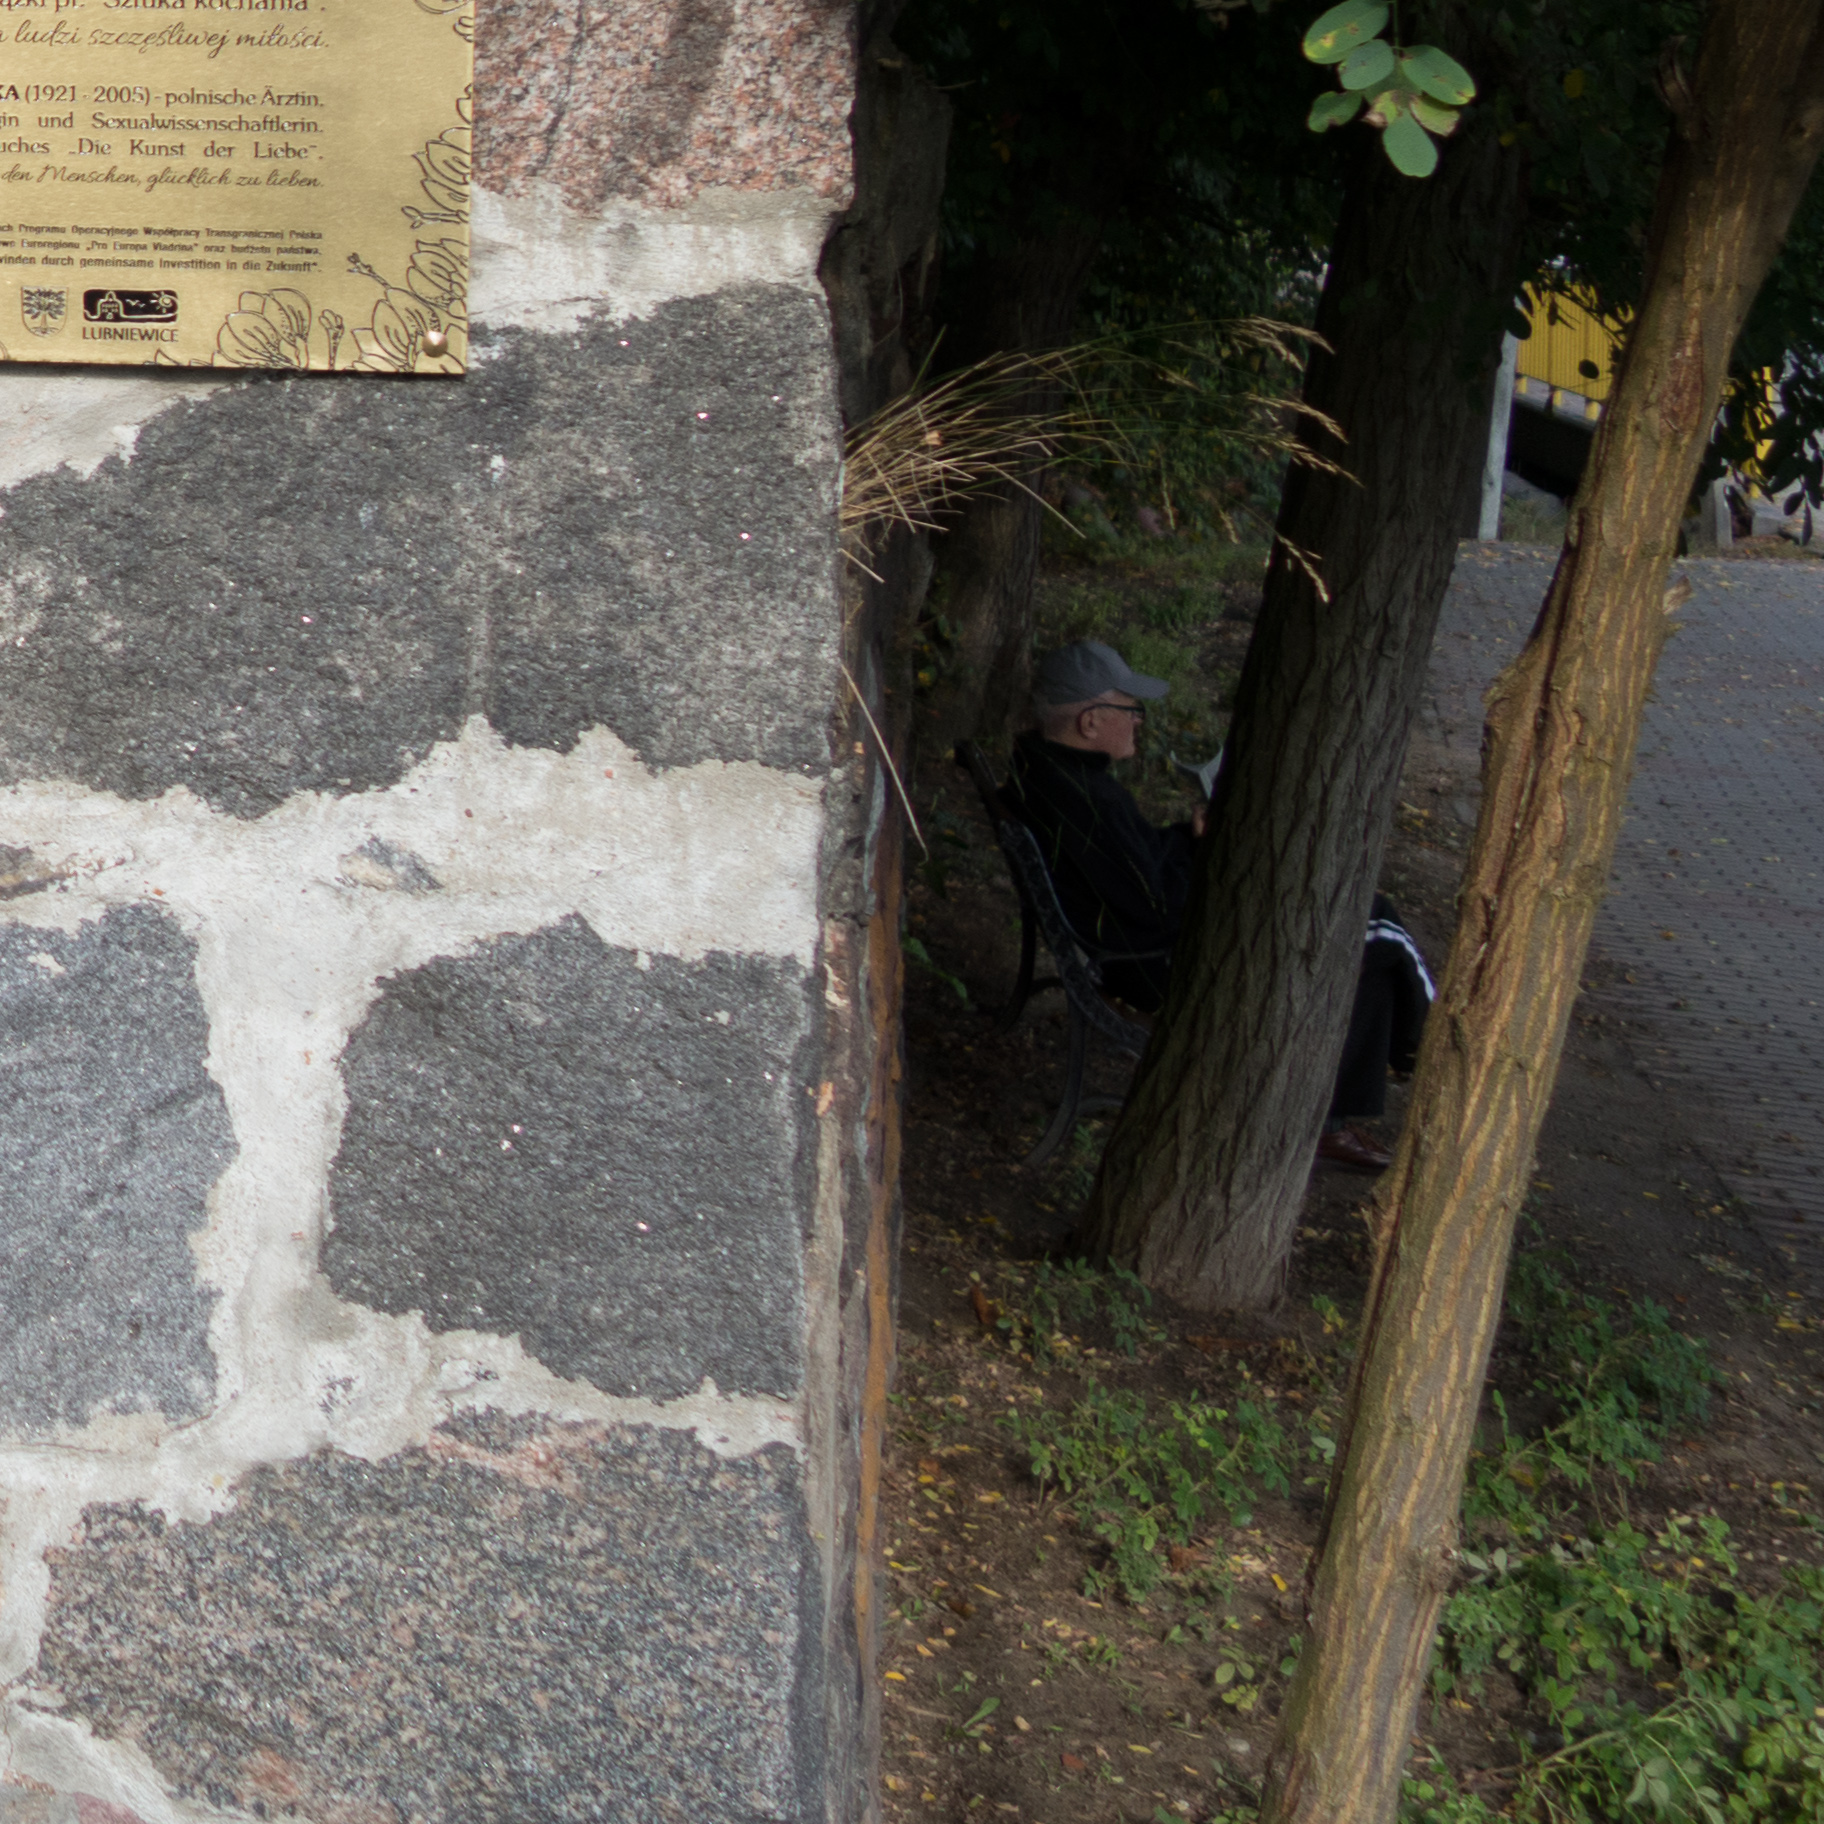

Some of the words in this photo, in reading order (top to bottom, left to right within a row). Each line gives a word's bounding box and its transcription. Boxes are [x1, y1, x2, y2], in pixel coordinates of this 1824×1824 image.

[14, 19, 82, 46] ludzi
[88, 21, 230, 59] szczęśliwej
[236, 24, 329, 48] miłości.
[25, 85, 75, 103] (1921
[94, 86, 150, 106] 2005)
[165, 87, 256, 107] polnische
[1, 163, 33, 183] den
[37, 164, 141, 186] Menschen,
[145, 167, 231, 192] glücklich
[236, 177, 262, 186] zu
[266, 169, 323, 187] lieben.
[81, 326, 179, 343] LUBNIEWICE
